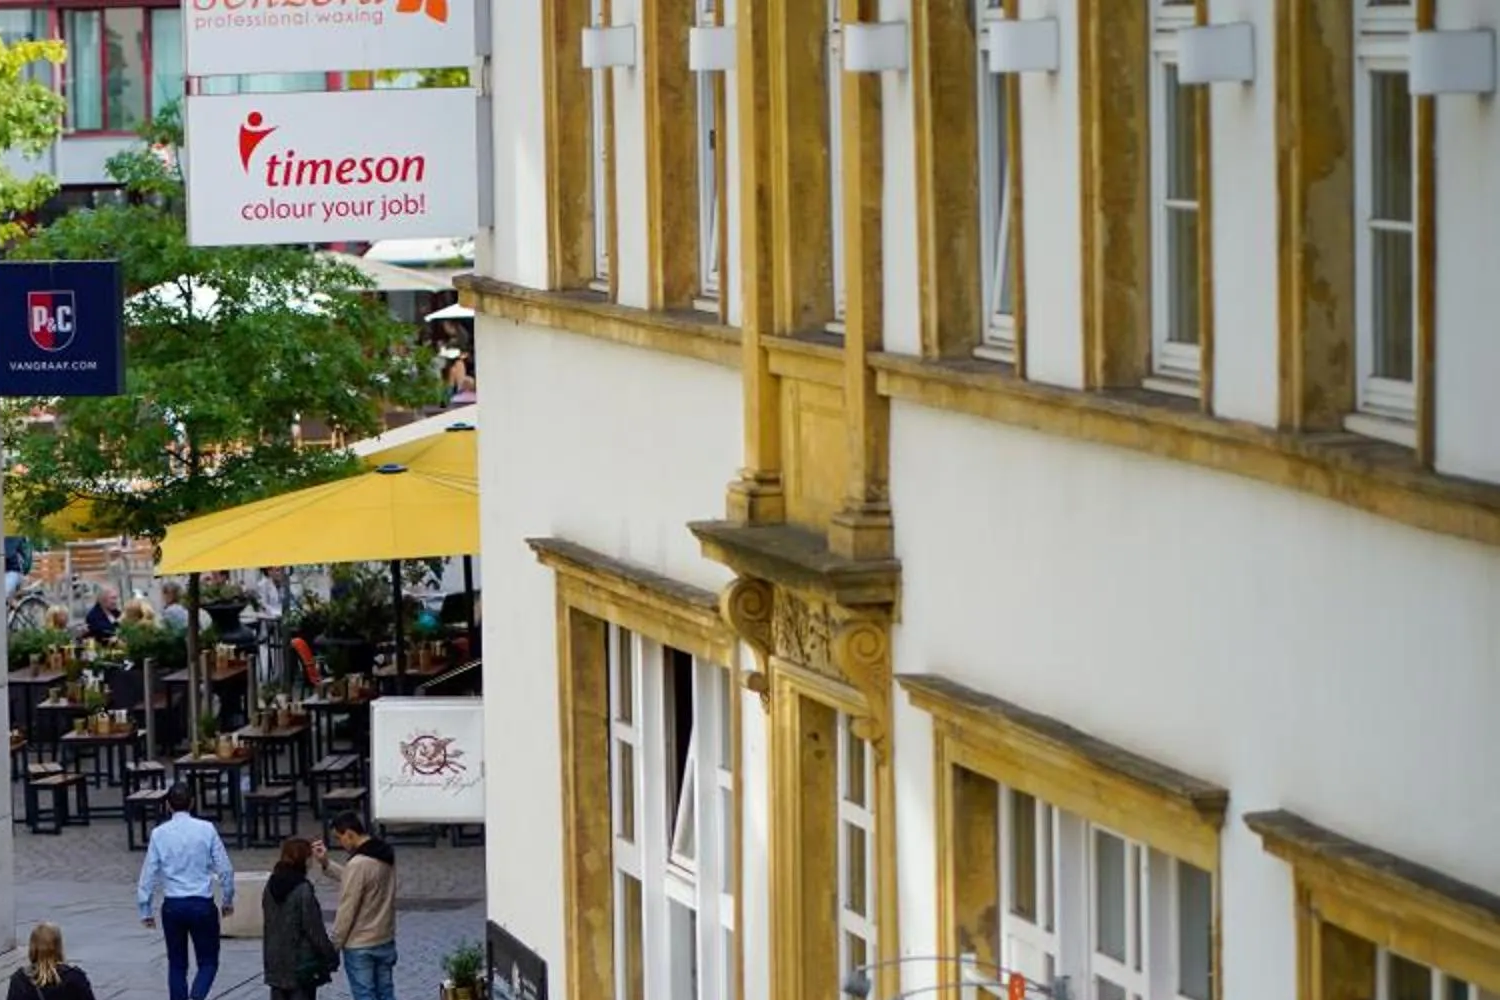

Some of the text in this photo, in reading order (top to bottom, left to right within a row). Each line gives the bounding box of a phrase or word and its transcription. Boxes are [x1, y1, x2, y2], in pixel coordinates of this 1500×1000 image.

[194, 9, 384, 30] professional waxing
[265, 149, 426, 188] timeson
[241, 193, 426, 223] colour your job!
[31, 305, 73, 333] P&C
[9, 361, 98, 371] VANGRAAF.COM
